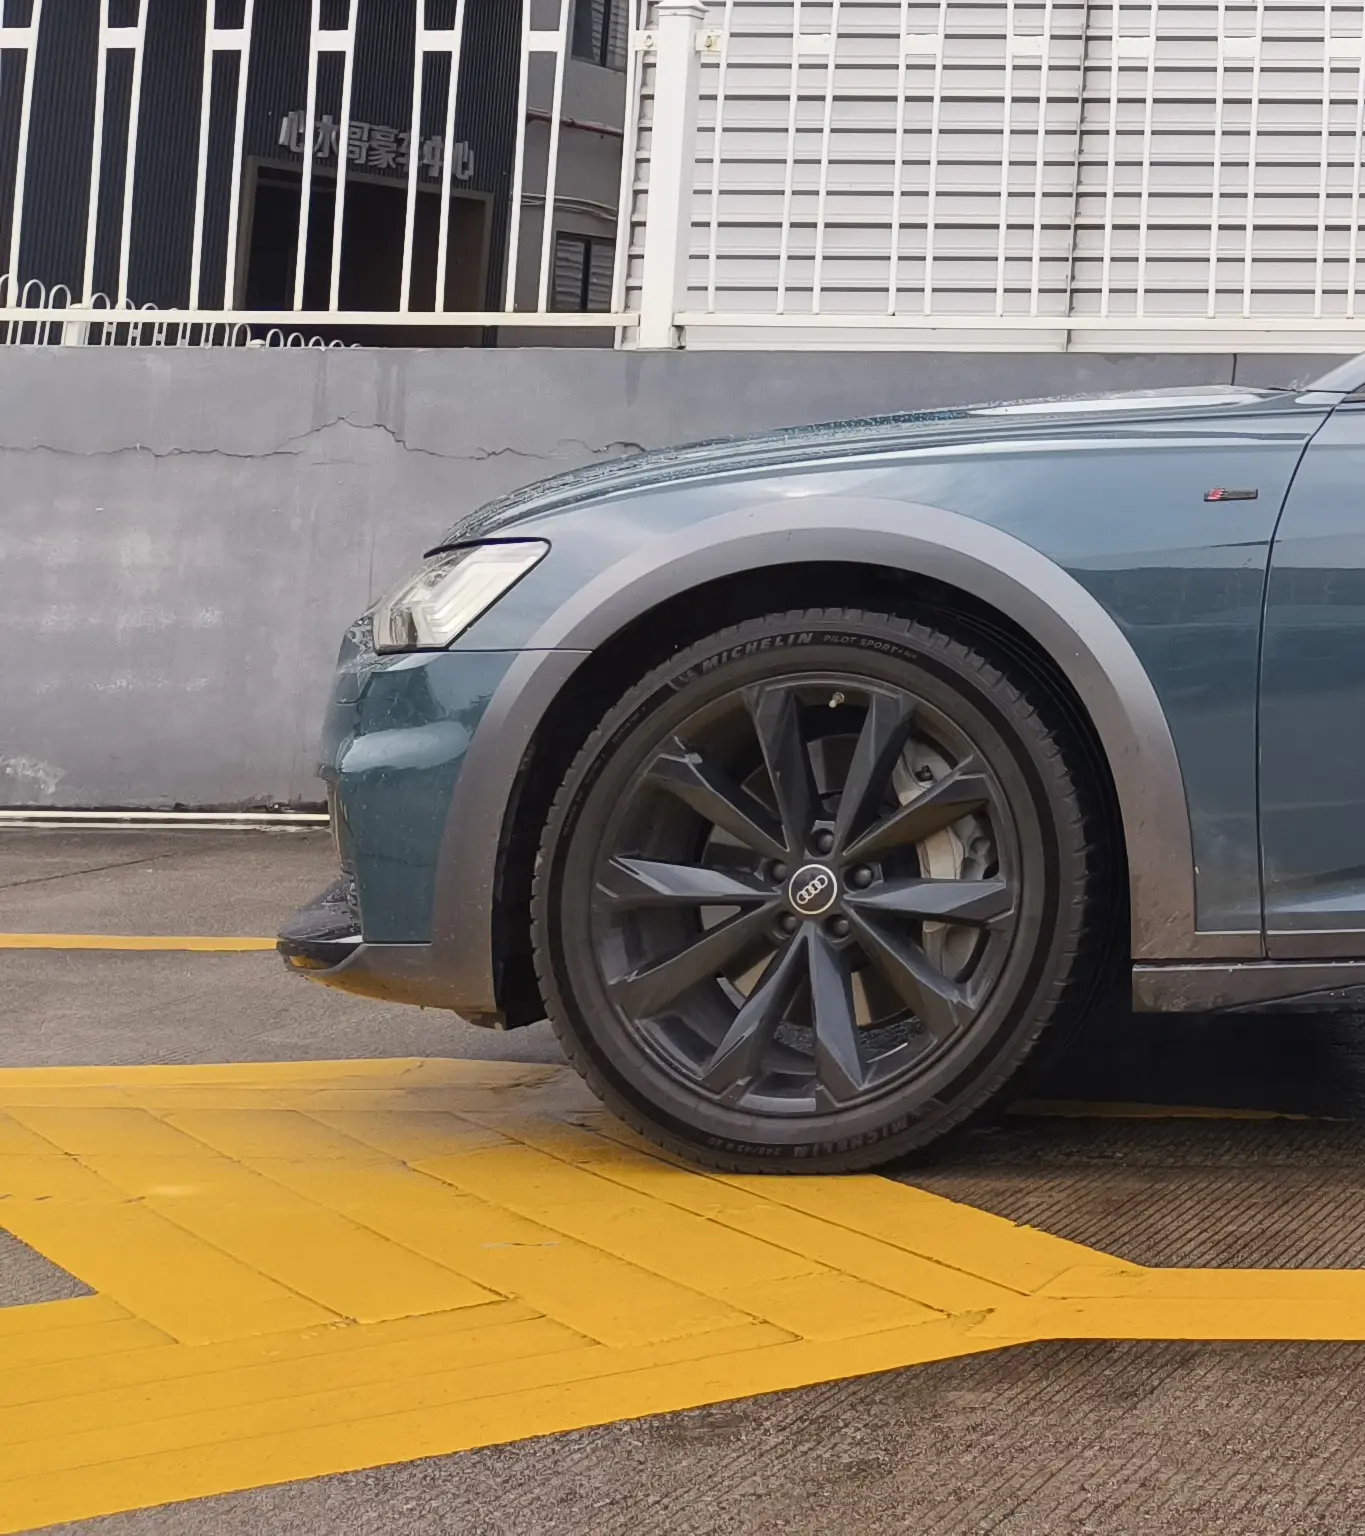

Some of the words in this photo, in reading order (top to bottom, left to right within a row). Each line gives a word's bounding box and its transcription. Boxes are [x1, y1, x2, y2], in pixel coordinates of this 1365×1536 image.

[702, 632, 814, 674] MICHELIN
[822, 634, 857, 645] PILOT
[859, 638, 899, 654] SPORT
